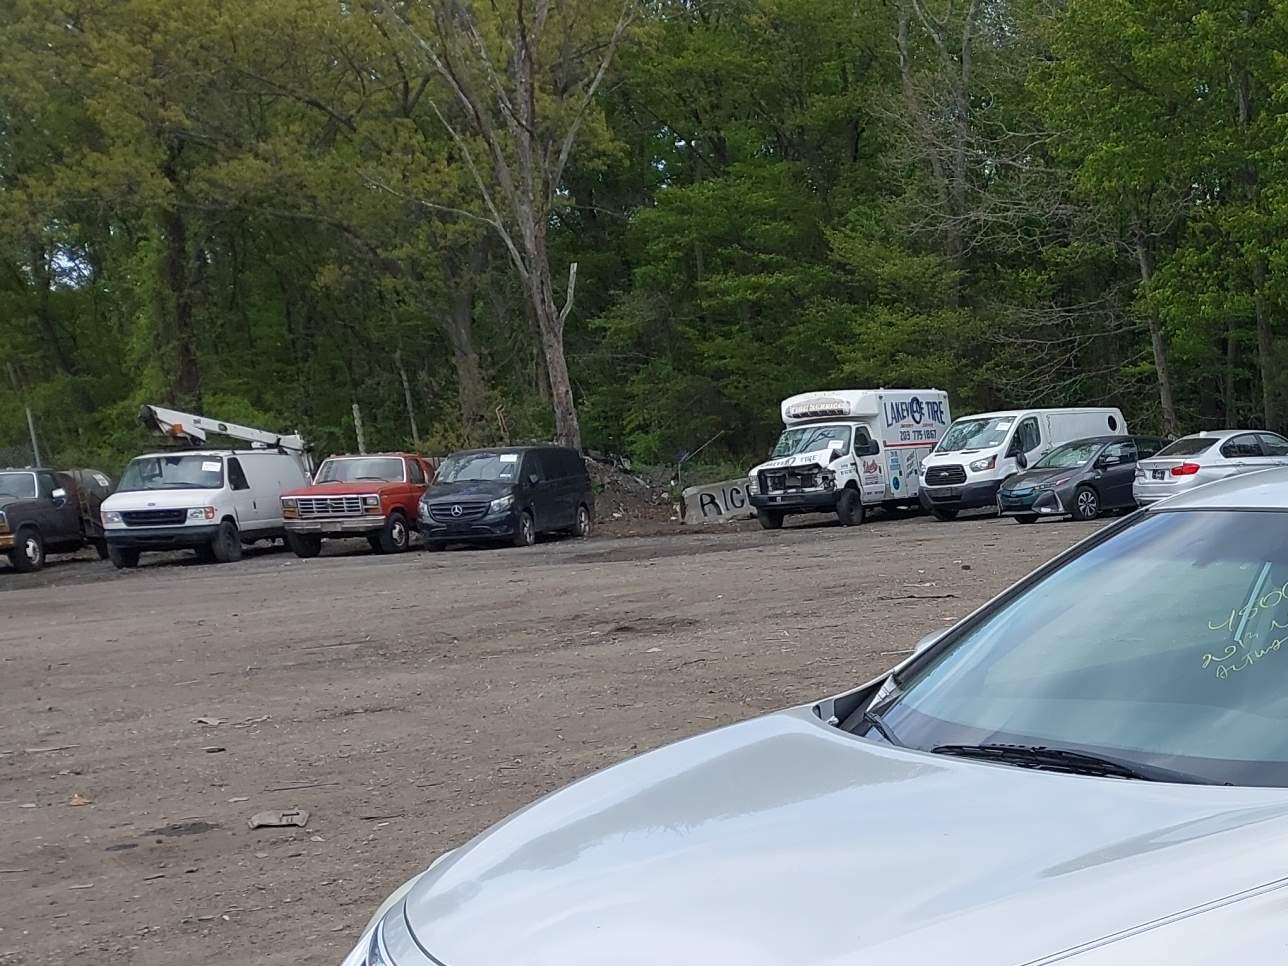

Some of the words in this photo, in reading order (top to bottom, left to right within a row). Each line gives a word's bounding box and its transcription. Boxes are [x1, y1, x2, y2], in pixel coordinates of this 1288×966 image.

[925, 400, 945, 425] TIRE
[899, 430, 910, 441] 203
[700, 485, 750, 517] RIC
